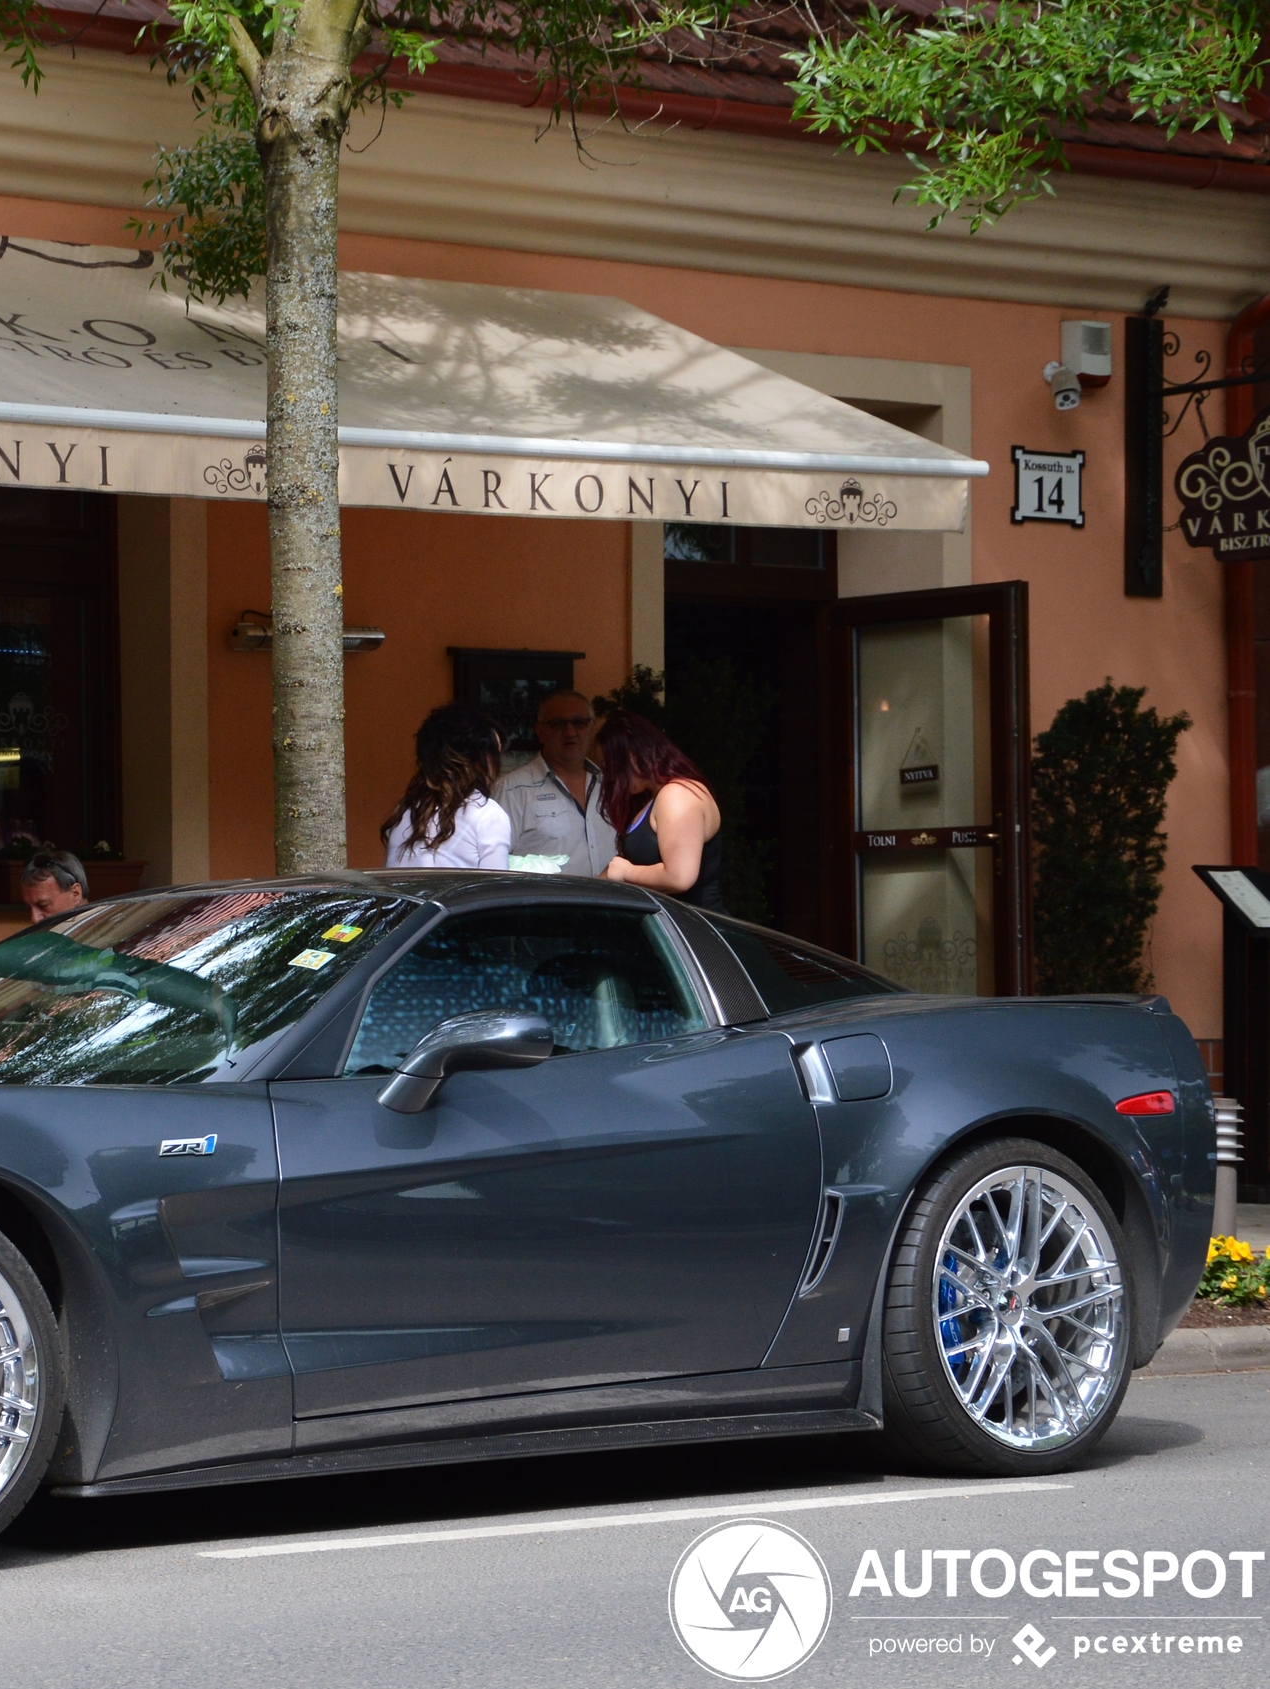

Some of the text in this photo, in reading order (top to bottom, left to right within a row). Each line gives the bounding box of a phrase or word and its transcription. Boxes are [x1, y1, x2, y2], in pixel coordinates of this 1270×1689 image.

[143, 345, 214, 370] ÉS
[1023, 459, 1075, 474] Kossuth u.
[387, 457, 732, 518] VÁRKONYI
[1032, 476, 1065, 514] 14
[1186, 509, 1270, 538] VÁRK
[1219, 533, 1270, 552] BISZTR
[904, 769, 934, 782] NYITVA
[867, 834, 896, 847] TOLNI
[161, 1134, 217, 1155] ZR1
